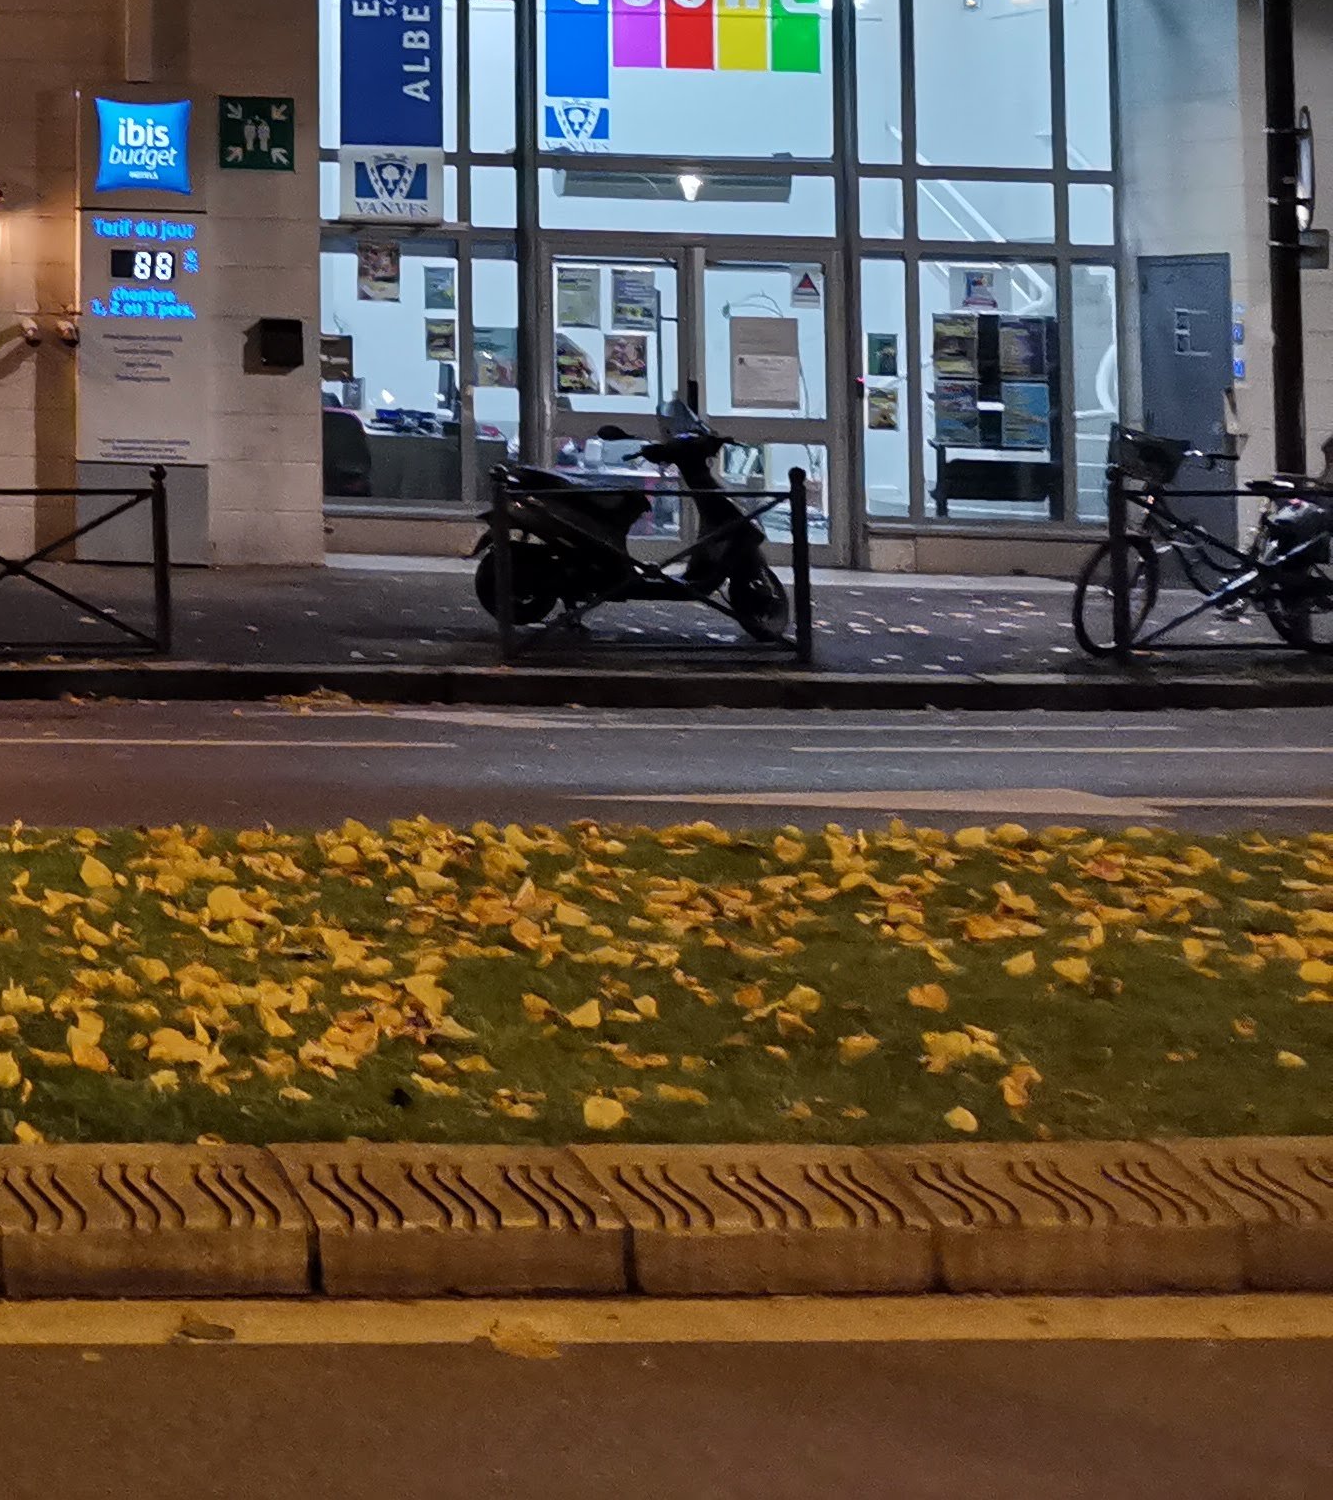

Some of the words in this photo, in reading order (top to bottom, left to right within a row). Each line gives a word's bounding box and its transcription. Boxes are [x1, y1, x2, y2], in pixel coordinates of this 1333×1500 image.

[118, 117, 170, 148] ibis
[108, 144, 178, 171] budget
[134, 251, 173, 281] 88
